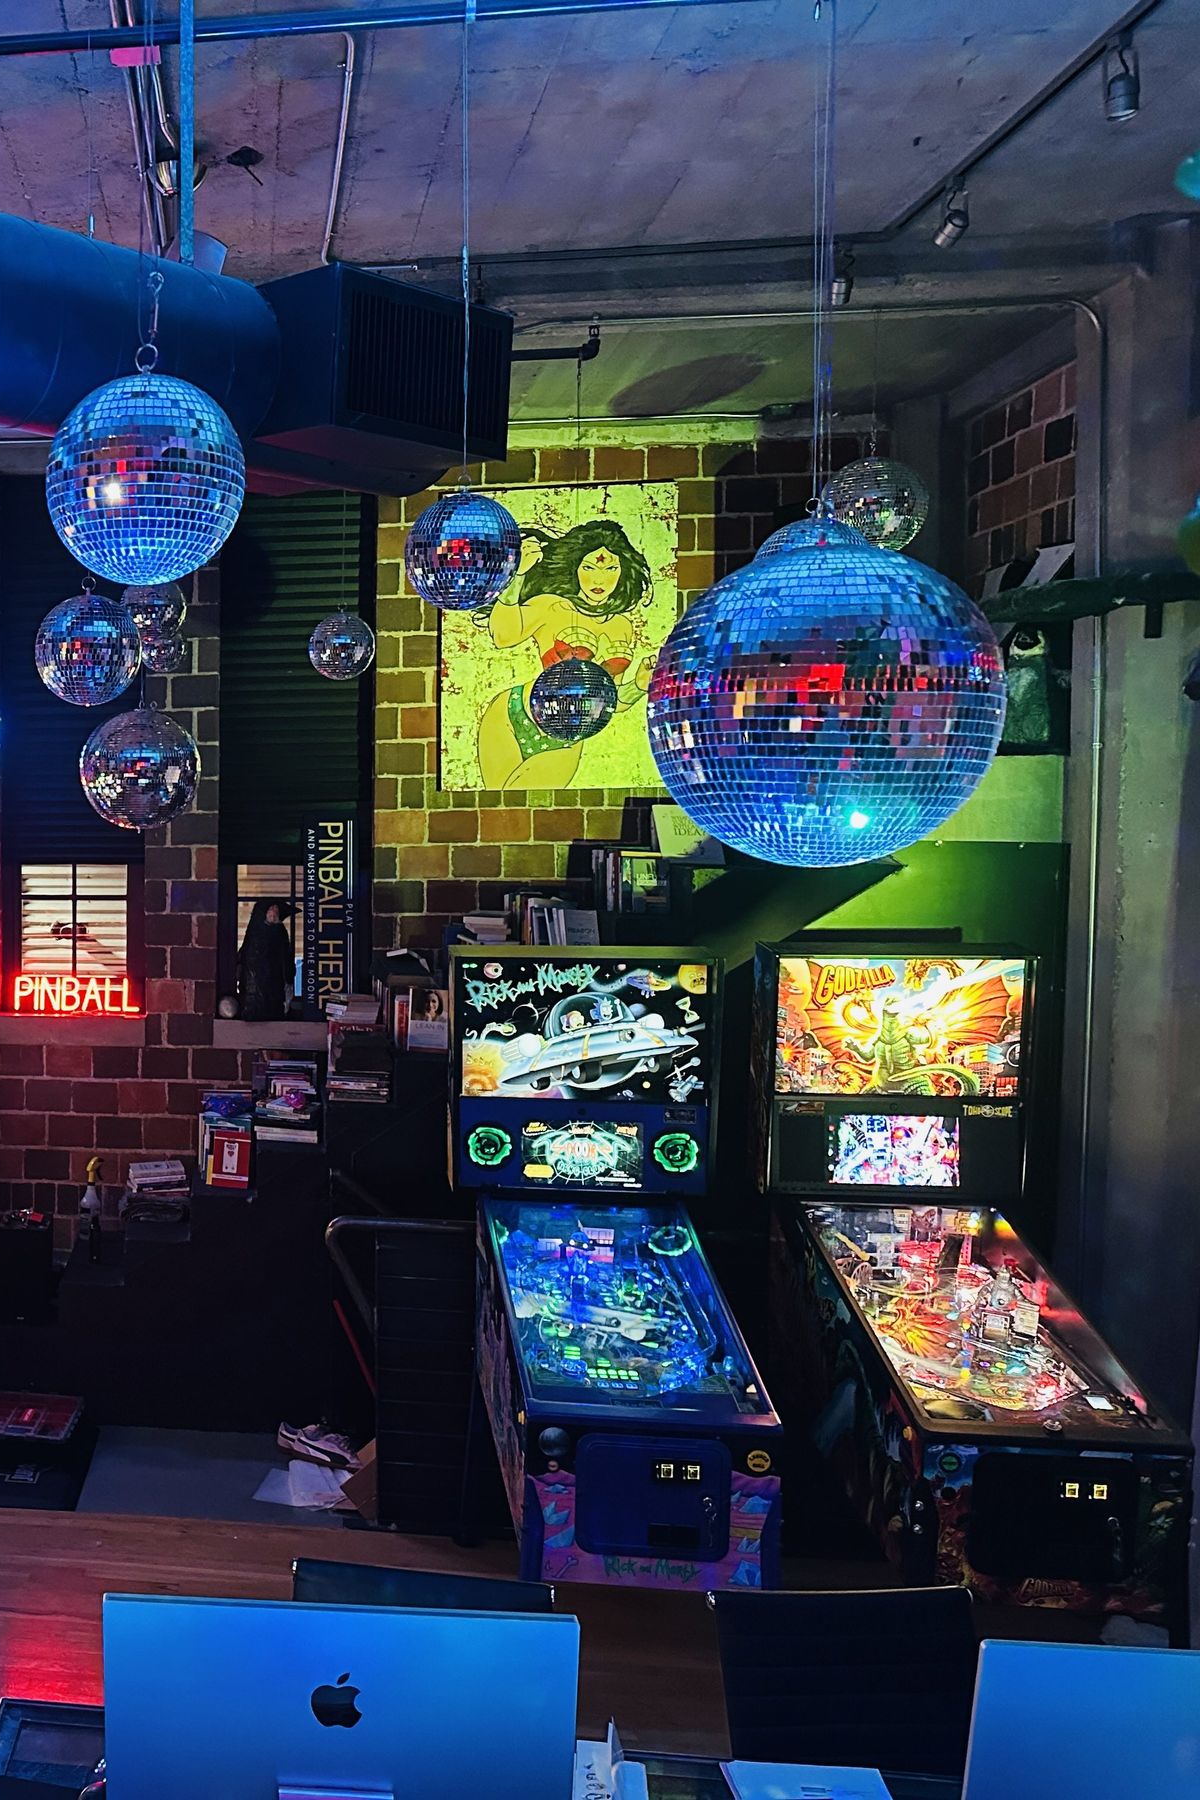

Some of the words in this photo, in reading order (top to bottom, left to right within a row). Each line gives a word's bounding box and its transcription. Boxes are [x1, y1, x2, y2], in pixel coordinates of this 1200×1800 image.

[307, 828, 316, 850] AND
[307, 853, 316, 892] MUSHIE
[318, 822, 344, 933] PINBALL
[307, 896, 316, 924] TRIPS
[346, 903, 354, 928] PLAY
[307, 929, 316, 942] TO
[307, 947, 316, 965] THE
[13, 976, 140, 1012] PINBALL
[307, 969, 316, 1004] MOON!
[814, 963, 897, 1008] GODZILLA
